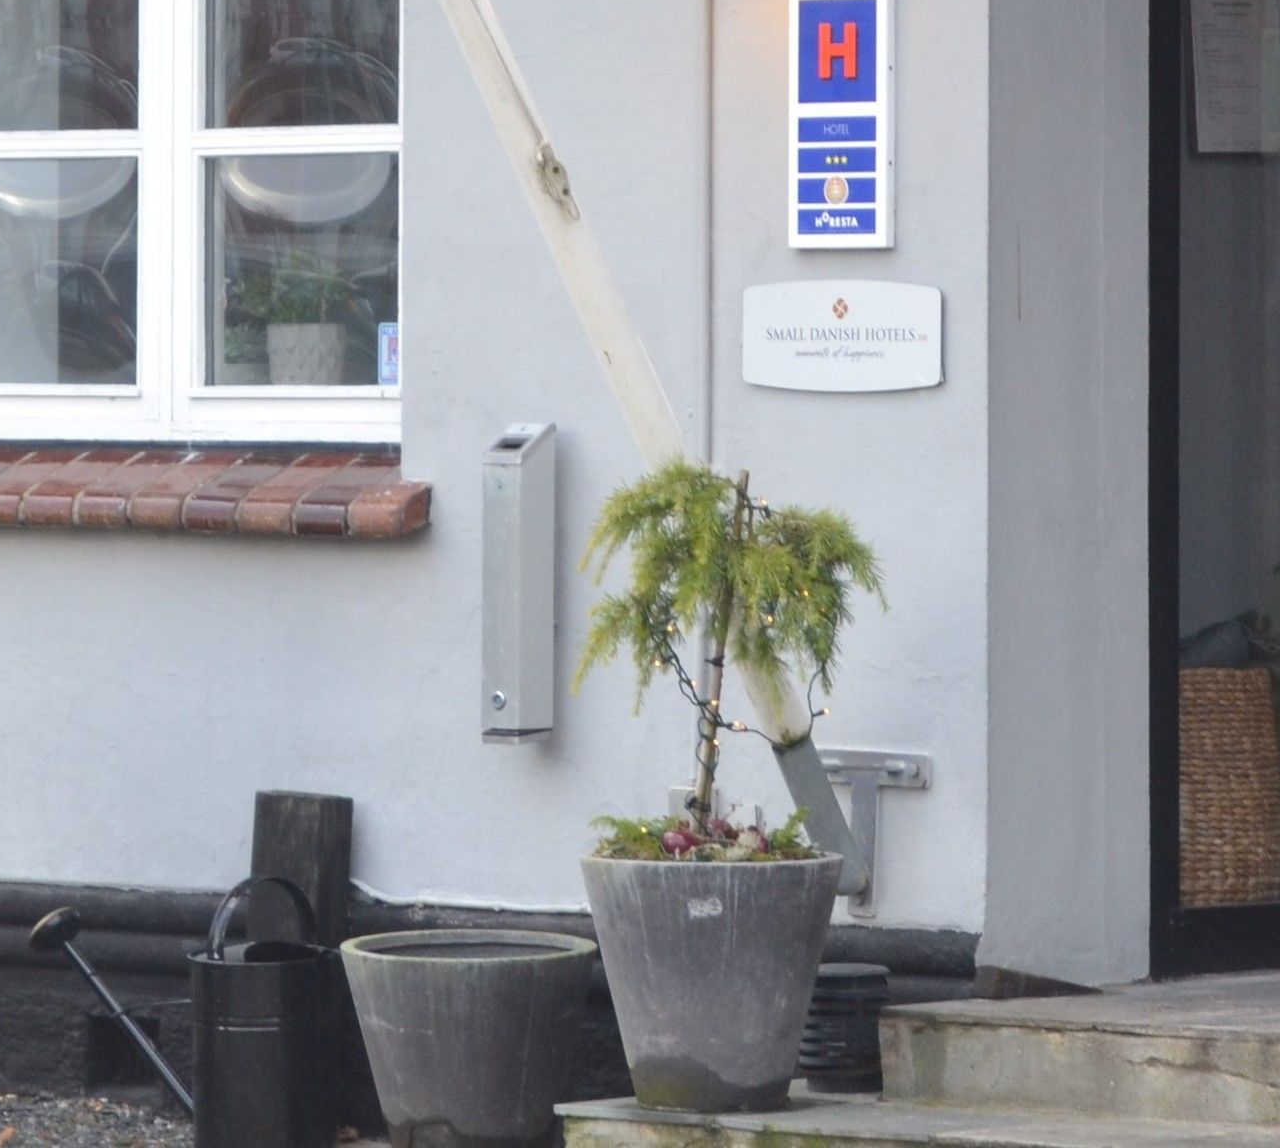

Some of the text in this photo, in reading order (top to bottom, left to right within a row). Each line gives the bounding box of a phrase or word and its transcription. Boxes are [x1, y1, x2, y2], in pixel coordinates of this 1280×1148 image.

[818, 22, 858, 80] H
[823, 123, 849, 135] HOTEL
[766, 327, 807, 341] SMALL
[810, 327, 860, 341] DANISH
